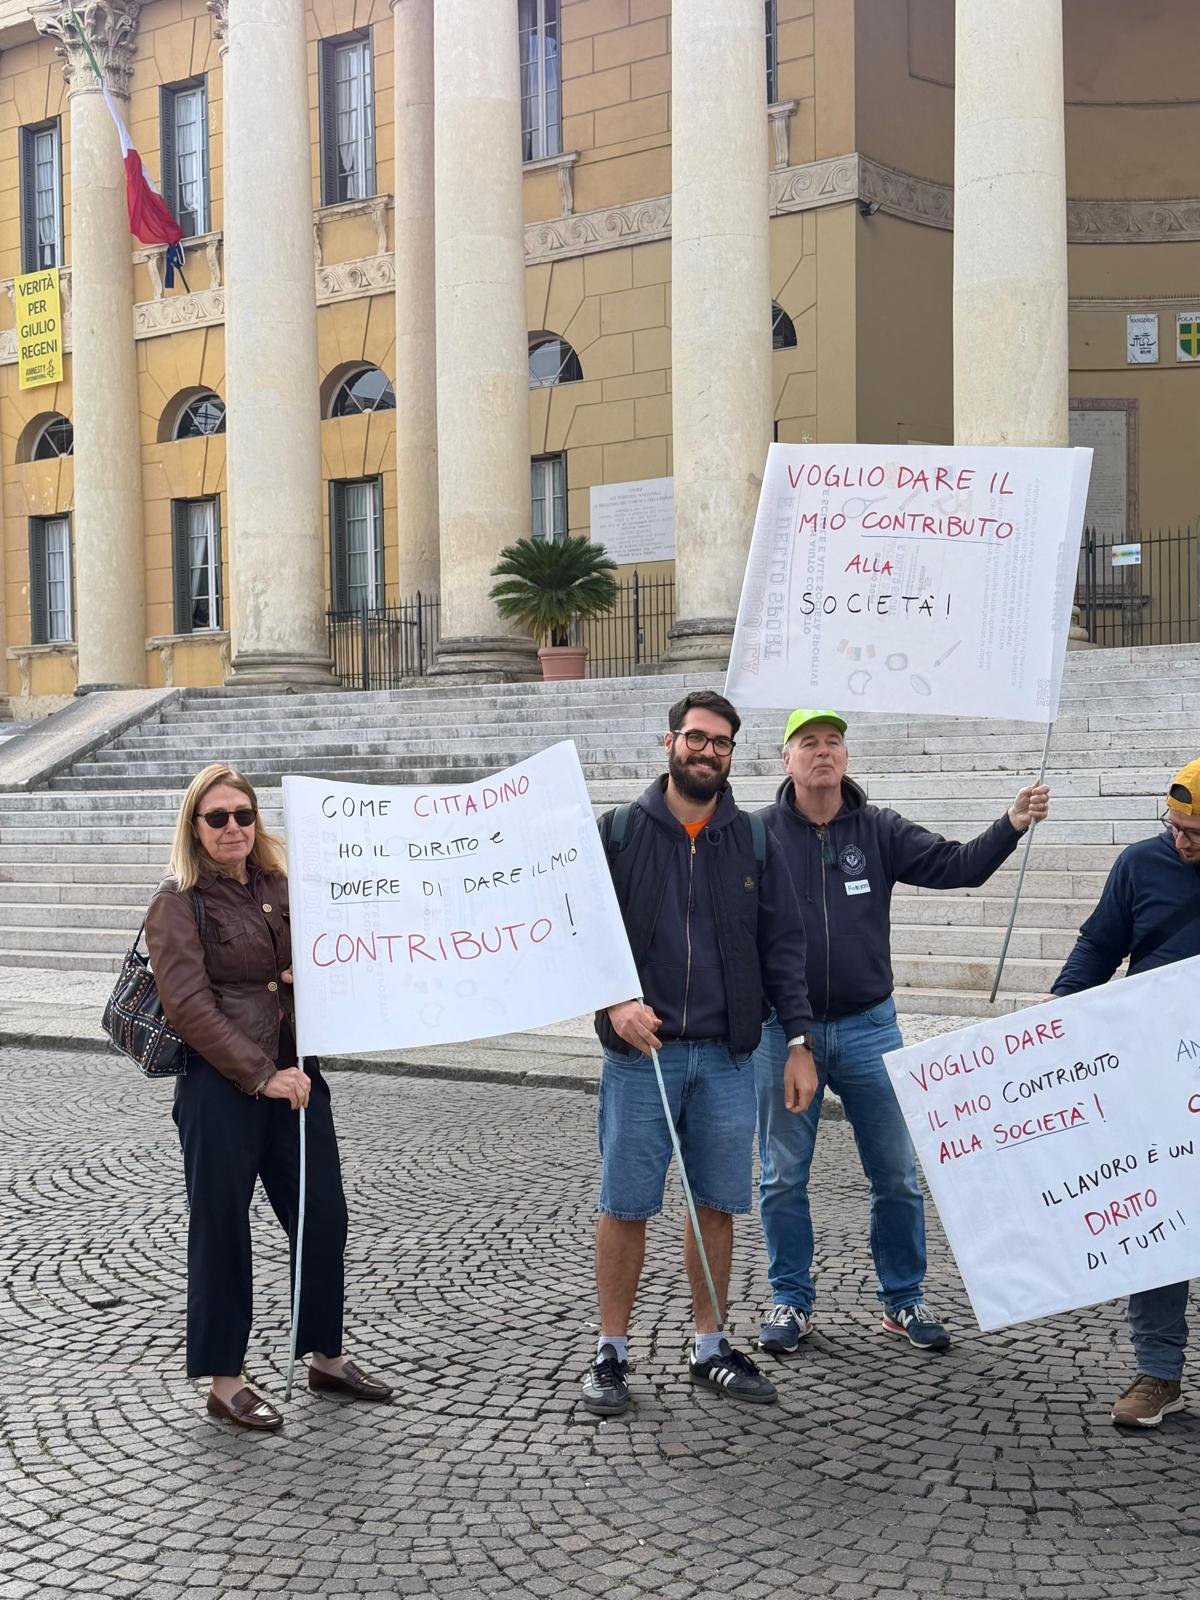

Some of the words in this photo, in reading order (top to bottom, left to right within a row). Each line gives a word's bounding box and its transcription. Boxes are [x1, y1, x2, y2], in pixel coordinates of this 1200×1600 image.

[19, 273, 54, 297] VERITÀ
[28, 299, 47, 316] PER
[21, 318, 56, 338] GIULIO
[21, 339, 58, 360] REGENI
[787, 463, 885, 489] VOGLIO
[897, 466, 976, 493] DARE
[990, 472, 1014, 495] IL
[798, 512, 847, 534] MIO
[861, 511, 1014, 539] CONTRIBUTO
[844, 553, 894, 577] ALLA
[321, 795, 392, 819] COME
[412, 775, 530, 818] CITTADINO
[338, 842, 363, 859] HO
[373, 844, 391, 858] IL
[408, 837, 479, 859] DIRITTO
[330, 879, 401, 901] DOVERE
[422, 880, 443, 897] DI
[463, 867, 523, 894] DARE
[909, 1045, 995, 1092] VOGLIO
[1004, 1018, 1066, 1055] DARE
[927, 1110, 949, 1132] IL
[953, 1094, 992, 1122] MIO
[1002, 1052, 1120, 1104] CONTRIBUTO
[939, 1133, 983, 1165] ALLA
[1041, 1189, 1063, 1207] IL
[1063, 1154, 1138, 1200] LAVORO
[1168, 1139, 1194, 1159] UN
[1084, 1188, 1158, 1237] DIRITTO
[1086, 1251, 1108, 1271] DI
